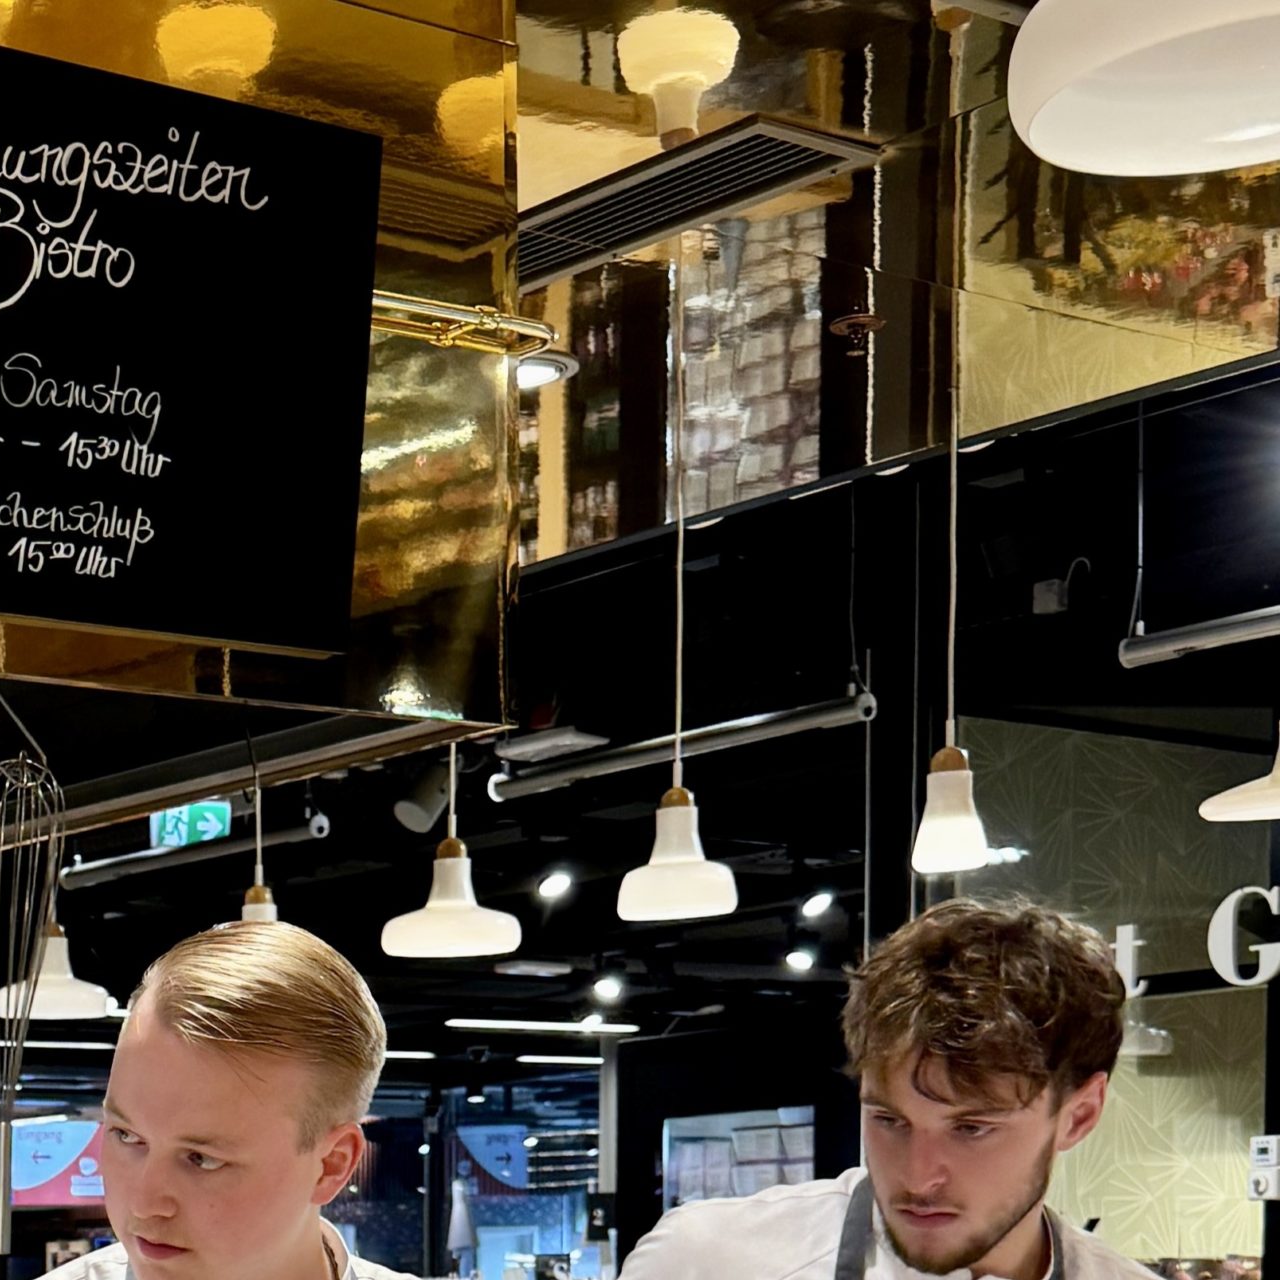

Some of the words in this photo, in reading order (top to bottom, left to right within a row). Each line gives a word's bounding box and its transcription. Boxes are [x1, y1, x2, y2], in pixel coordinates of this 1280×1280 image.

[0, 352, 163, 443] Samstag
[120, 438, 172, 477] Uhr
[75, 545, 125, 578] Uhr
[1109, 923, 1150, 999] t
[1207, 885, 1280, 987] G
